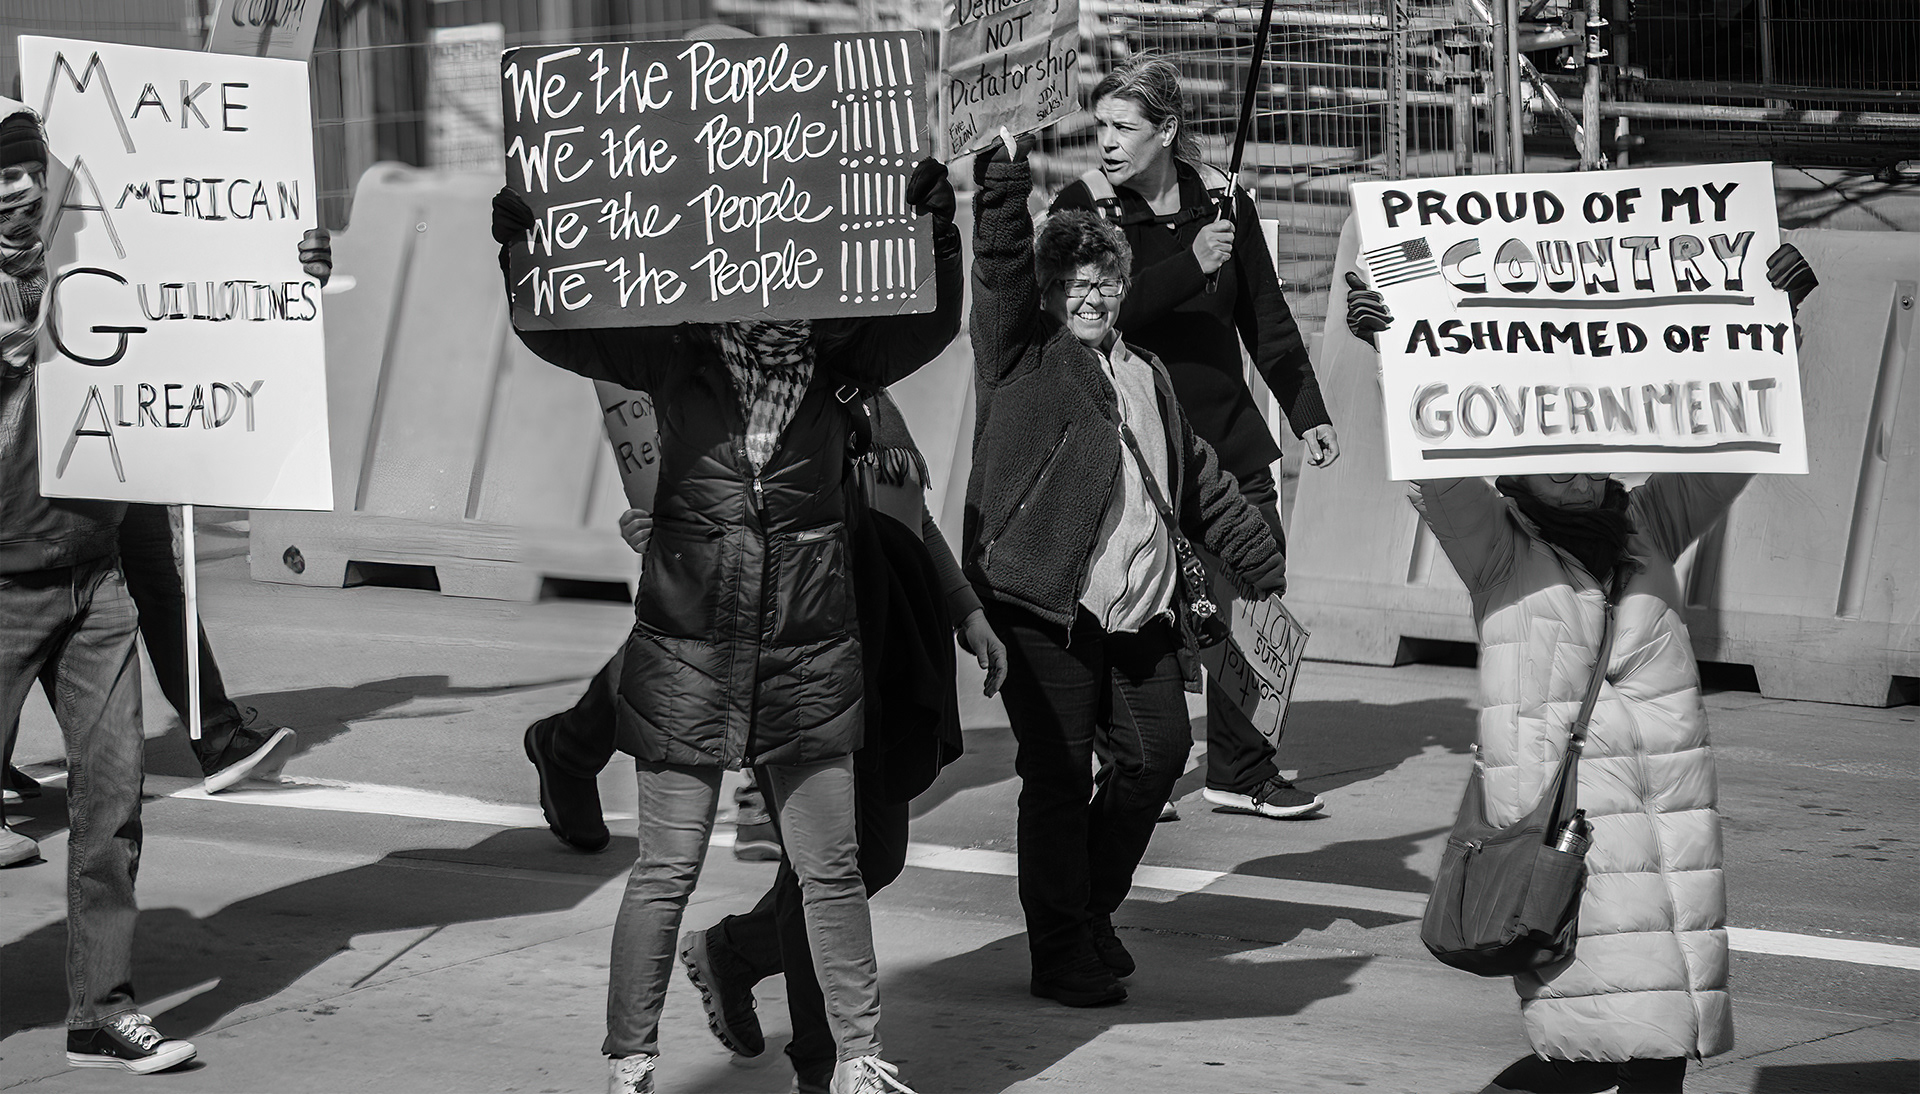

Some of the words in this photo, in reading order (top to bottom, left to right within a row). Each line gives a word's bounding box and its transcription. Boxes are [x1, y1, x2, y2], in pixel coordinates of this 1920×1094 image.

[985, 11, 1032, 54] NOT
[42, 50, 249, 154] MAKE
[504, 47, 583, 124] We
[587, 46, 674, 115] the
[677, 41, 829, 124] People
[950, 39, 1077, 116] Dictatorship
[506, 126, 595, 194] We
[600, 124, 678, 180] the
[694, 111, 838, 184] People
[45, 154, 300, 259] AMERICAN
[526, 198, 603, 258] We
[597, 191, 682, 241] the
[687, 176, 834, 252] People
[1380, 187, 1566, 229] PROUD
[1582, 187, 1643, 224] OF
[1660, 182, 1740, 225] MY
[518, 259, 608, 316] We
[604, 252, 688, 308] the
[690, 239, 824, 307] People
[1440, 230, 1756, 296] COUNTRY
[1404, 318, 1649, 358] ASHAMED
[1662, 323, 1712, 355] OF
[1726, 321, 1790, 356] MY
[56, 379, 265, 483] ALREADY
[1408, 376, 1780, 443] GOVERNMENT
[1218, 639, 1281, 738] Control
[1254, 636, 1288, 696] Guns
